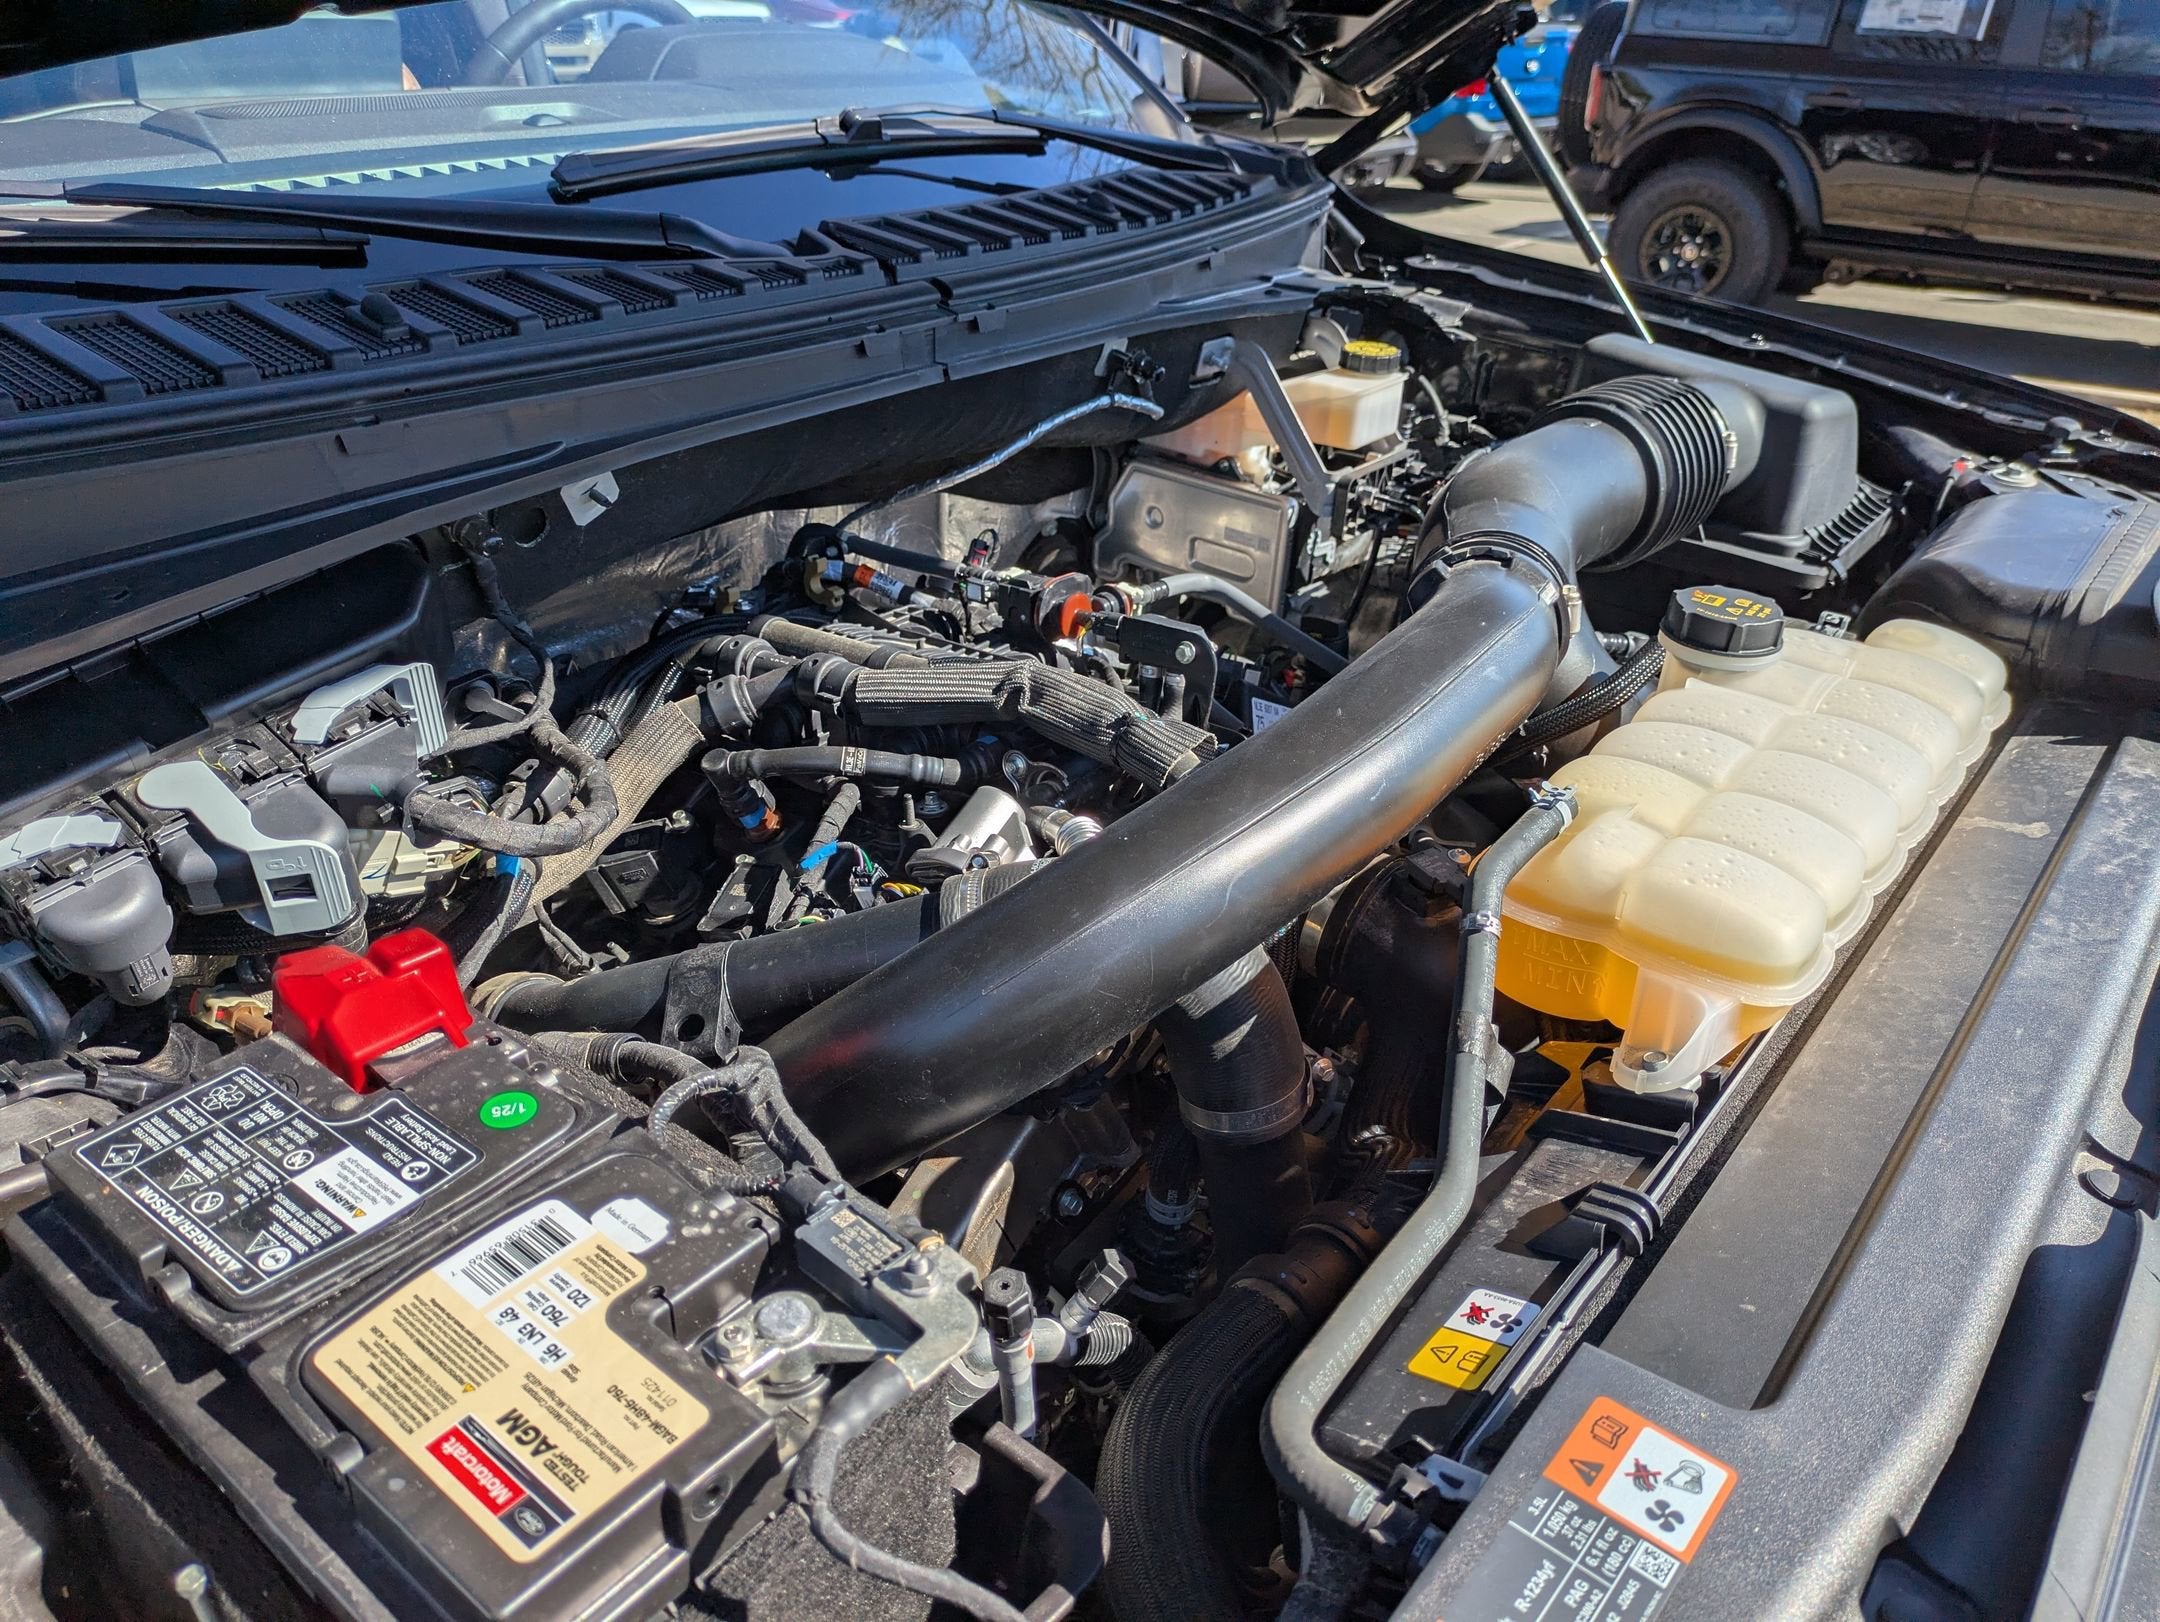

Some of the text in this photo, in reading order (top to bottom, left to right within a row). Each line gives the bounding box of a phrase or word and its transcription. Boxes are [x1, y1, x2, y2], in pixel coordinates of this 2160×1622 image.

[1525, 931, 1591, 965] MAX
[1523, 962, 1585, 995] MIN
[164, 1106, 200, 1132] GET MEDICAL
[178, 1104, 209, 1126] HELP FAST.
[236, 1117, 256, 1130] DO
[247, 1109, 271, 1124] NOT
[256, 1099, 287, 1120] OPEN.
[491, 1101, 527, 1118] 1/25
[130, 1126, 163, 1151] FLUSH EYES
[137, 1119, 173, 1146] IMMEDIATELY
[147, 1114, 183, 1140] WITH WATER.
[272, 1134, 297, 1151] OF THE
[278, 1124, 308, 1145] REACH OF
[381, 1115, 454, 1164] NON-SPILLABLE
[396, 1113, 459, 1155] Lead Acid Battery
[197, 1148, 229, 1171] CAN CAUSE
[200, 1136, 240, 1166] BLINDNESS OR
[255, 1136, 285, 1157] KEEP OUT
[361, 1126, 414, 1162] INSTRUCTIONS.
[379, 1151, 405, 1167] READ
[172, 1144, 218, 1179] SULFURIC ACID
[311, 1178, 359, 1213] WARNING:
[134, 1185, 233, 1265] DANGER/POISON
[271, 1191, 333, 1238] CAN CAUSE BLINDNESS
[607, 1207, 622, 1221] Made
[264, 1220, 309, 1254] SHIELD EYES.
[565, 1287, 591, 1308] 120
[539, 1303, 569, 1327] 760
[498, 1305, 567, 1363] H6 LN3 48
[639, 1375, 678, 1408] 011425
[519, 1380, 622, 1474] Manufactured for Ford Motor Company
[605, 1383, 678, 1445] BAGM-48H6-760
[495, 1406, 558, 1462] AGM
[437, 1435, 514, 1505] Motorcraft
[542, 1456, 580, 1492] TESTED
[1527, 1493, 1548, 1516] 3.5L
[1540, 1497, 1579, 1539] 1.050 kg
[1560, 1515, 1582, 1538] 37 oz
[1568, 1517, 1597, 1551] 2.31 lbs
[1583, 1526, 1619, 1568] 6.1 fl oz
[1599, 1533, 1636, 1578] (180 cc)
[1512, 1559, 1560, 1614] R-1234yf
[1562, 1578, 1591, 1608] PAG
